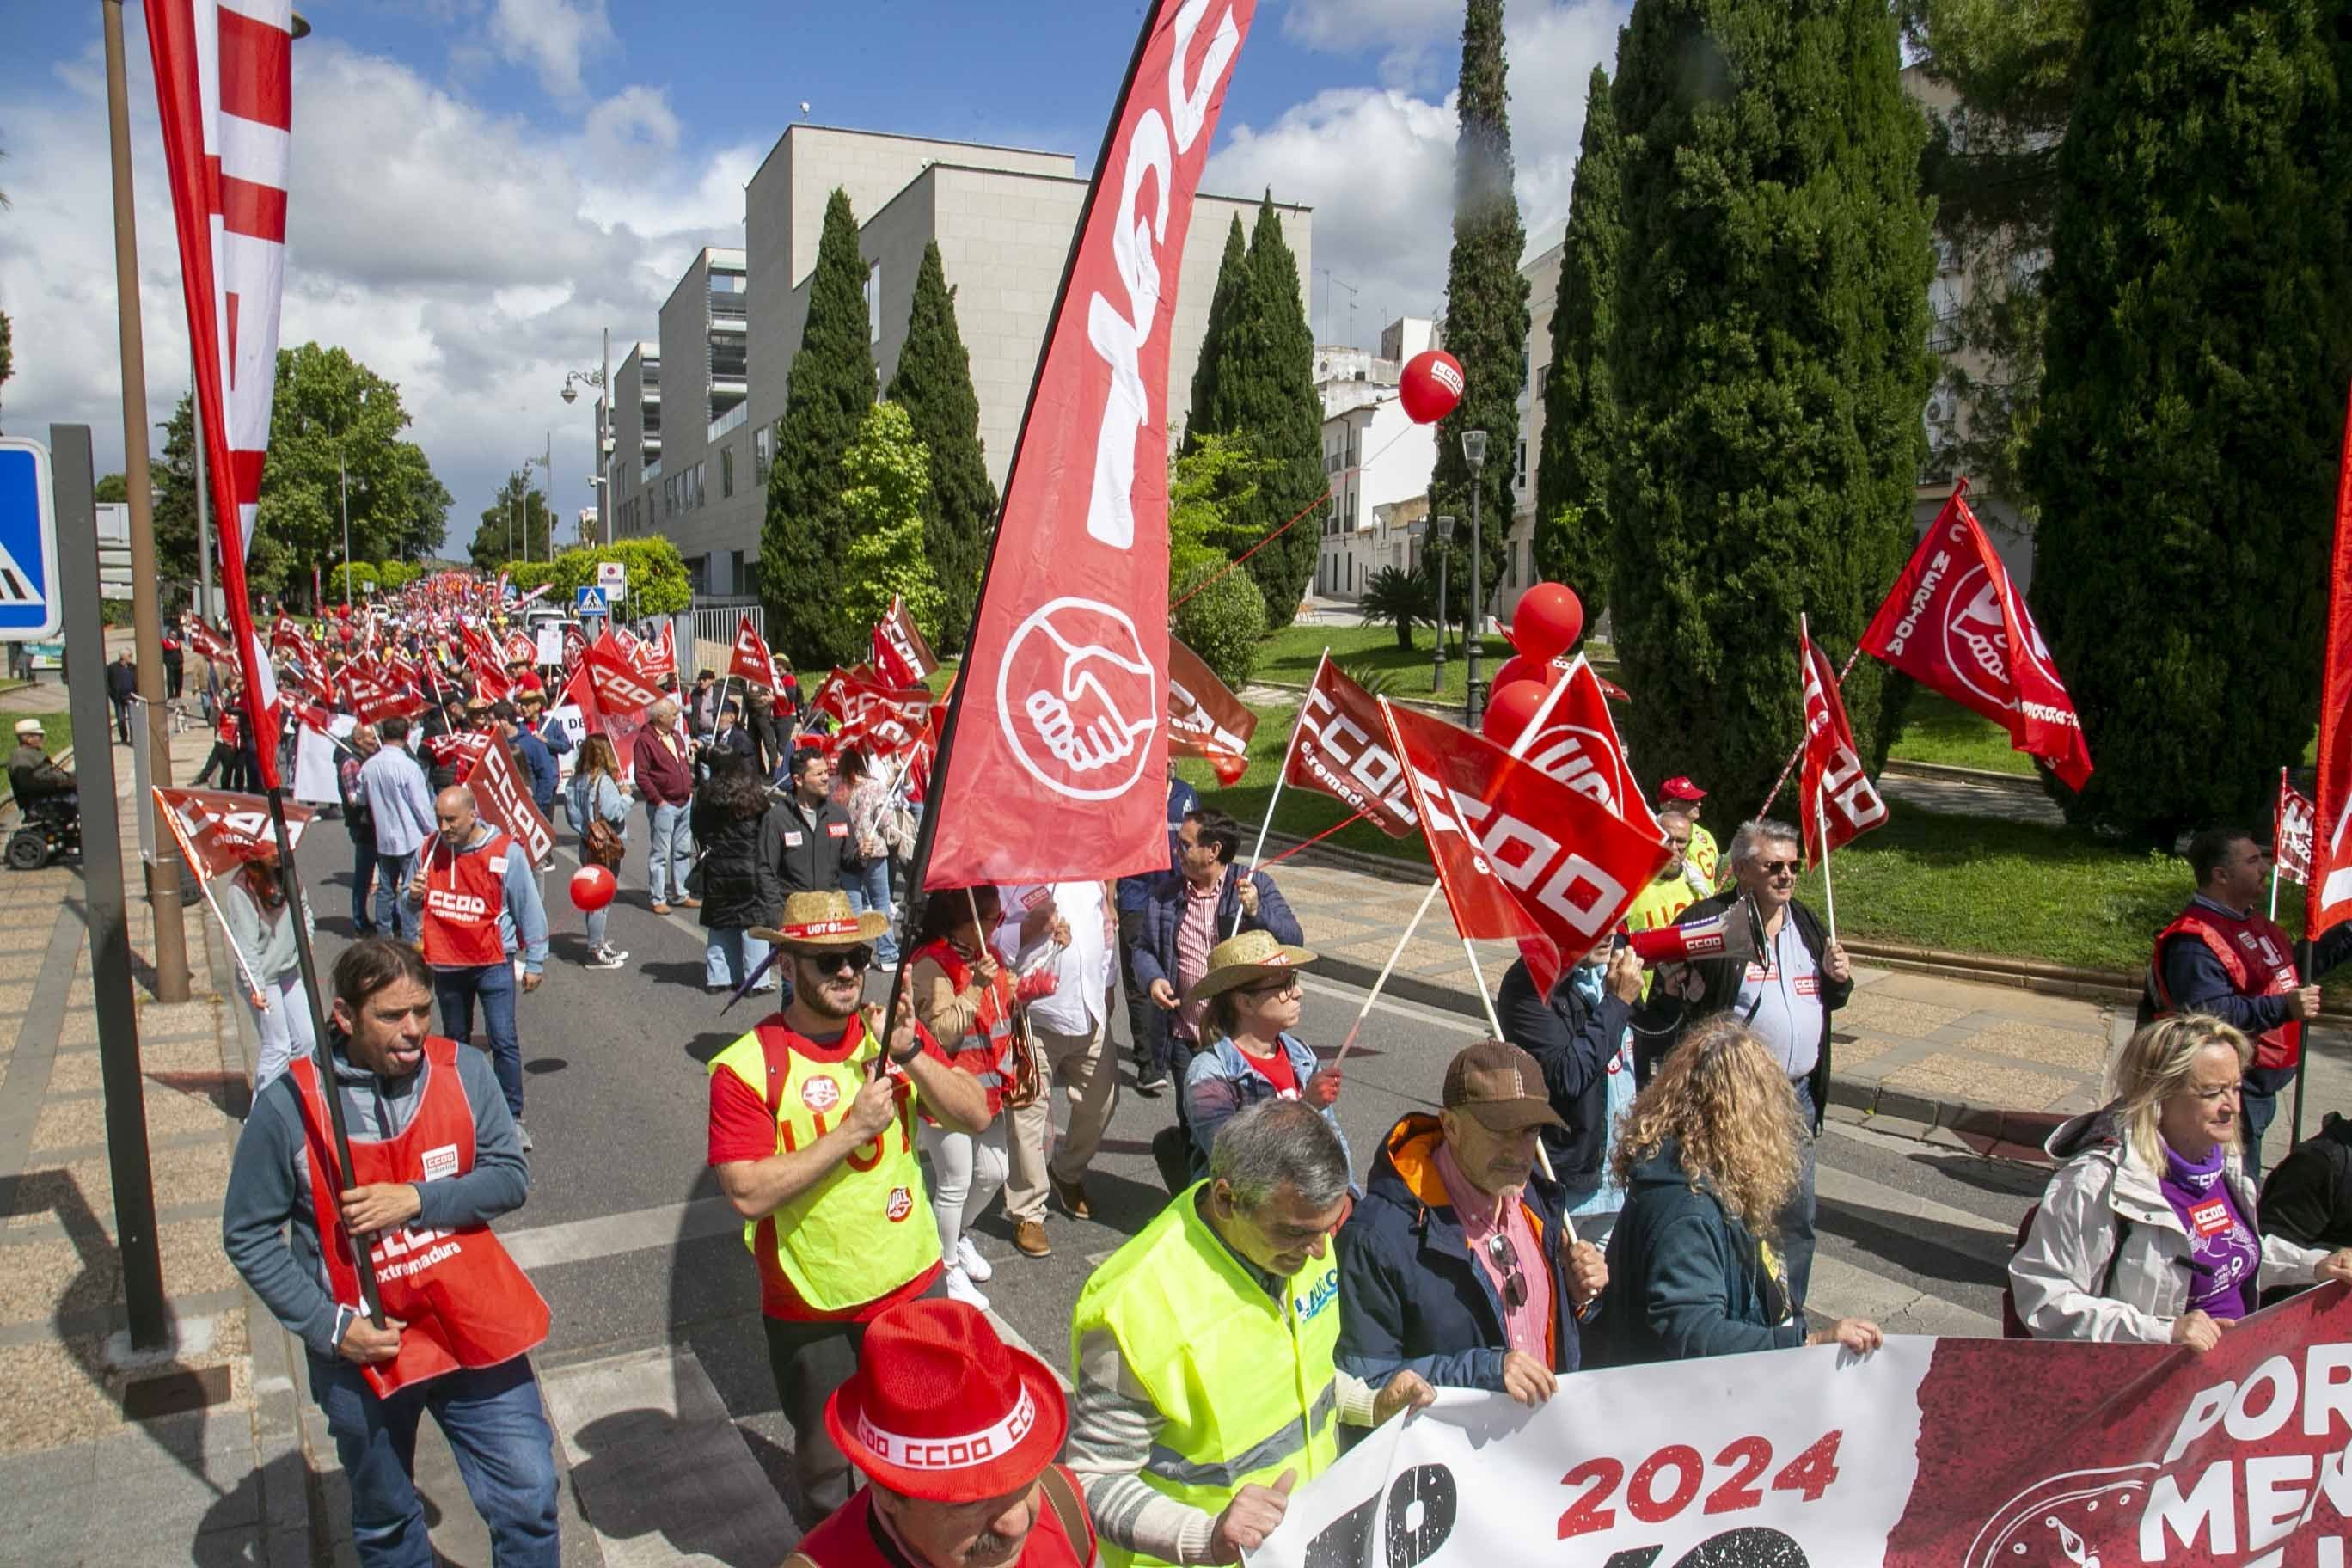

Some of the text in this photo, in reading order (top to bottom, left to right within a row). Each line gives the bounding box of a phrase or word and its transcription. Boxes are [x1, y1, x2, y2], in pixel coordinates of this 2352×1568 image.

[1087, 0, 1239, 549] UGT
[484, 743, 552, 861] CCOO
[428, 889, 486, 915] CCOO
[1686, 937, 1721, 950] CCOO
[428, 1152, 455, 1167] CCOO
[2194, 1204, 2227, 1225] CCOO
[2162, 1342, 2352, 1465] POR
[905, 1435, 993, 1467] CCOO
[1557, 1428, 1843, 1541] 2024
